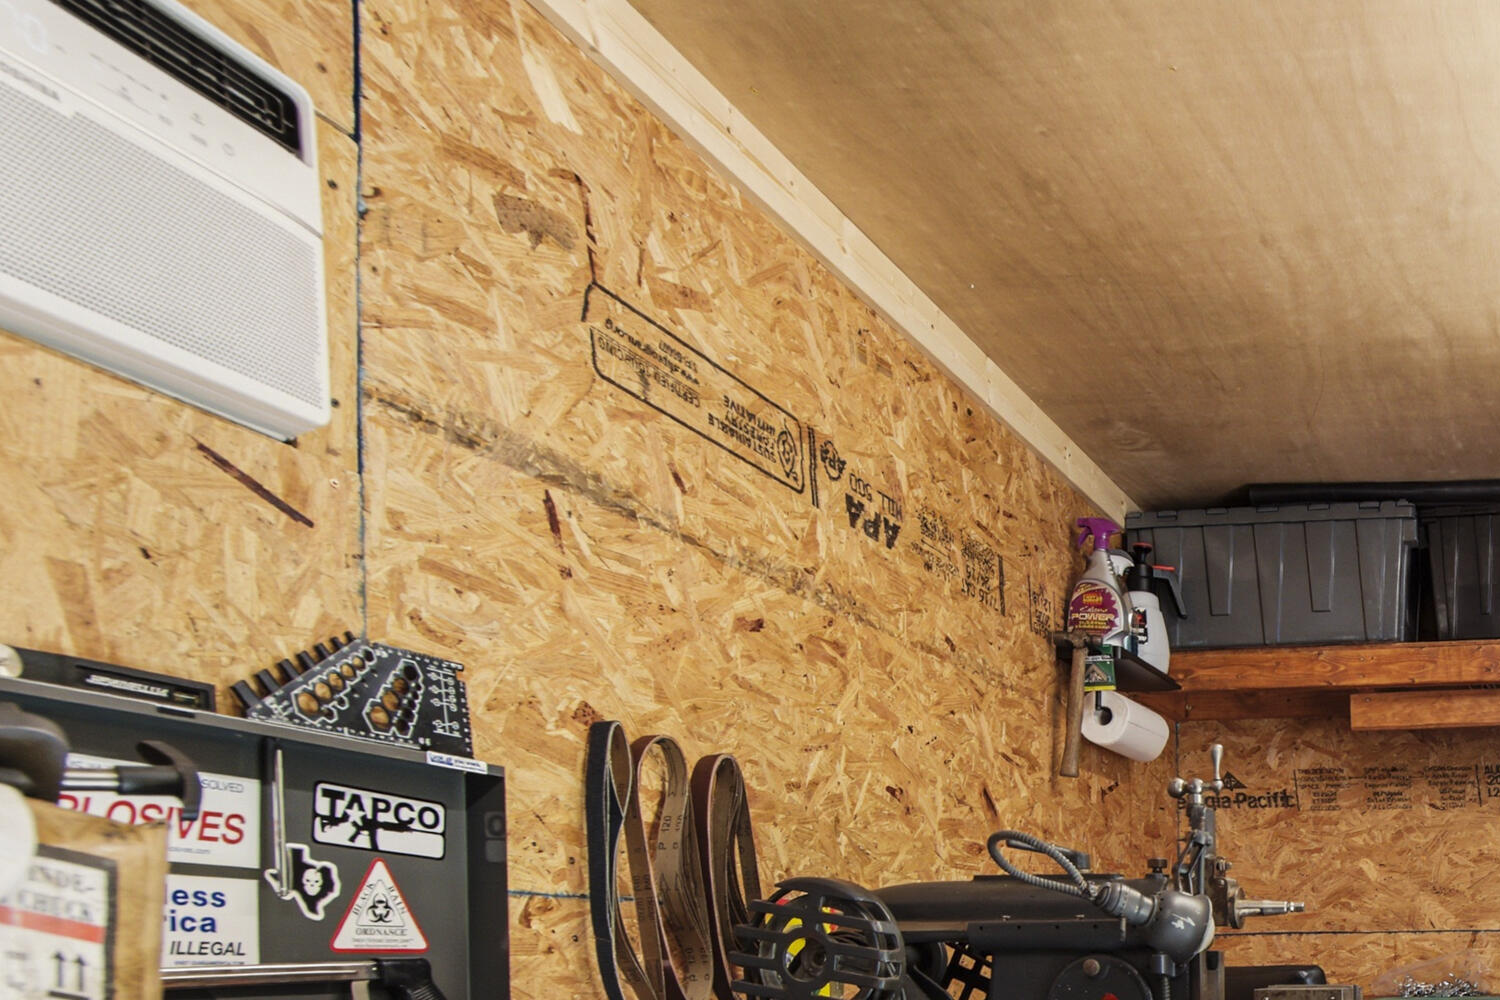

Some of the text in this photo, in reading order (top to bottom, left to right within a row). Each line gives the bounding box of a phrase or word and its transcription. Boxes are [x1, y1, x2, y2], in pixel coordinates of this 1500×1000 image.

[723, 394, 776, 436] INITIATIVE
[724, 410, 776, 451] FORESTRY
[707, 412, 778, 464] SUSTAINABLE
[844, 492, 903, 551] APA
[1071, 612, 1116, 621] POWER
[320, 786, 441, 830] TAPCO
[169, 940, 247, 957] ILLEGAL
